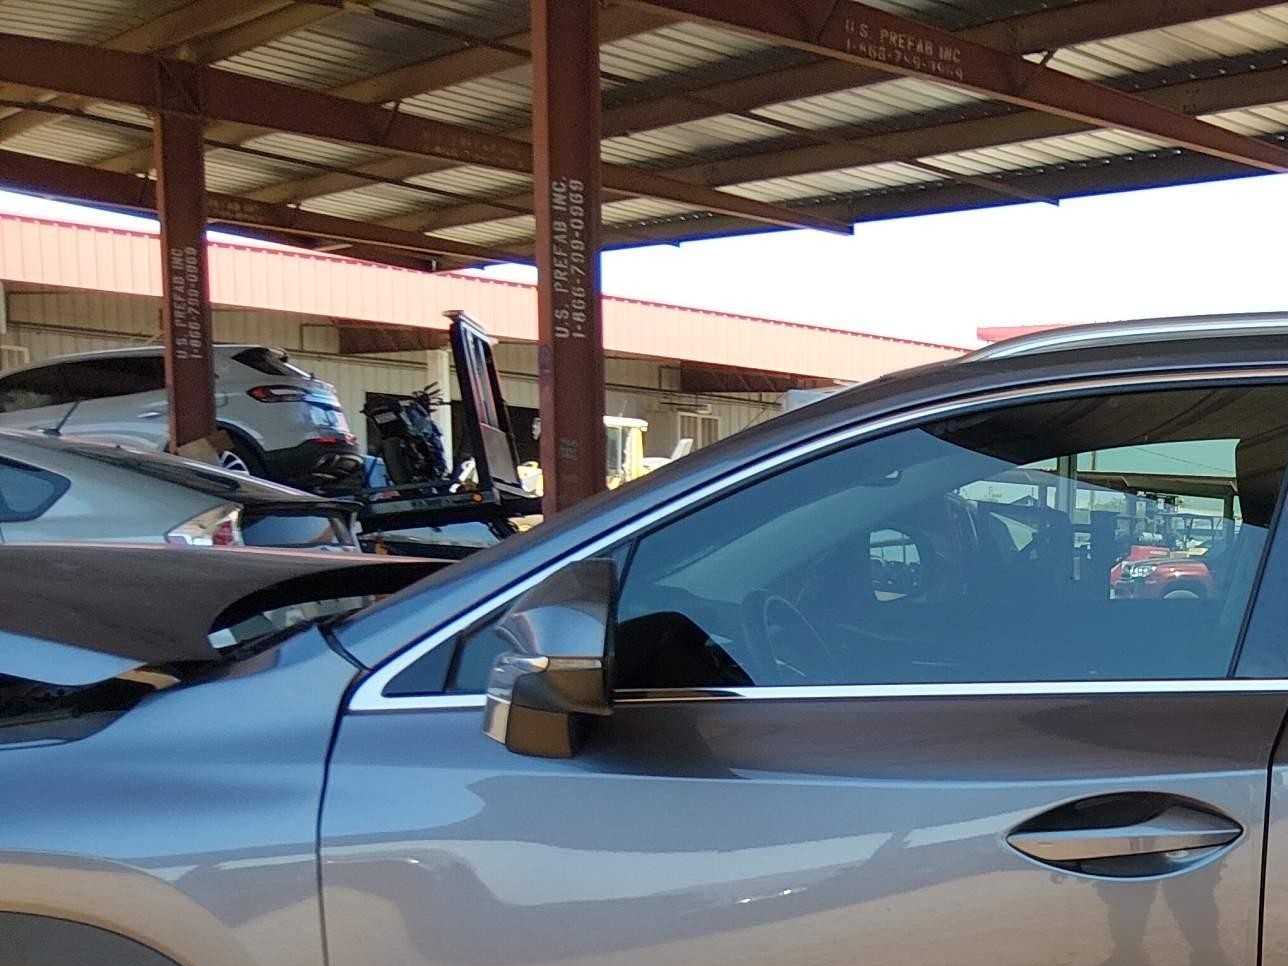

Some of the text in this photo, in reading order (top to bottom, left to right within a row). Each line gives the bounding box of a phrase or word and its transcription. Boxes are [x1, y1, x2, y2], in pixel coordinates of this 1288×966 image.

[879, 28, 934, 57] PREFAB
[172, 275, 187, 327] PREFAB
[551, 175, 570, 339] U.S. PREFAB INC.
[569, 179, 587, 339] 1-866-799-0969
